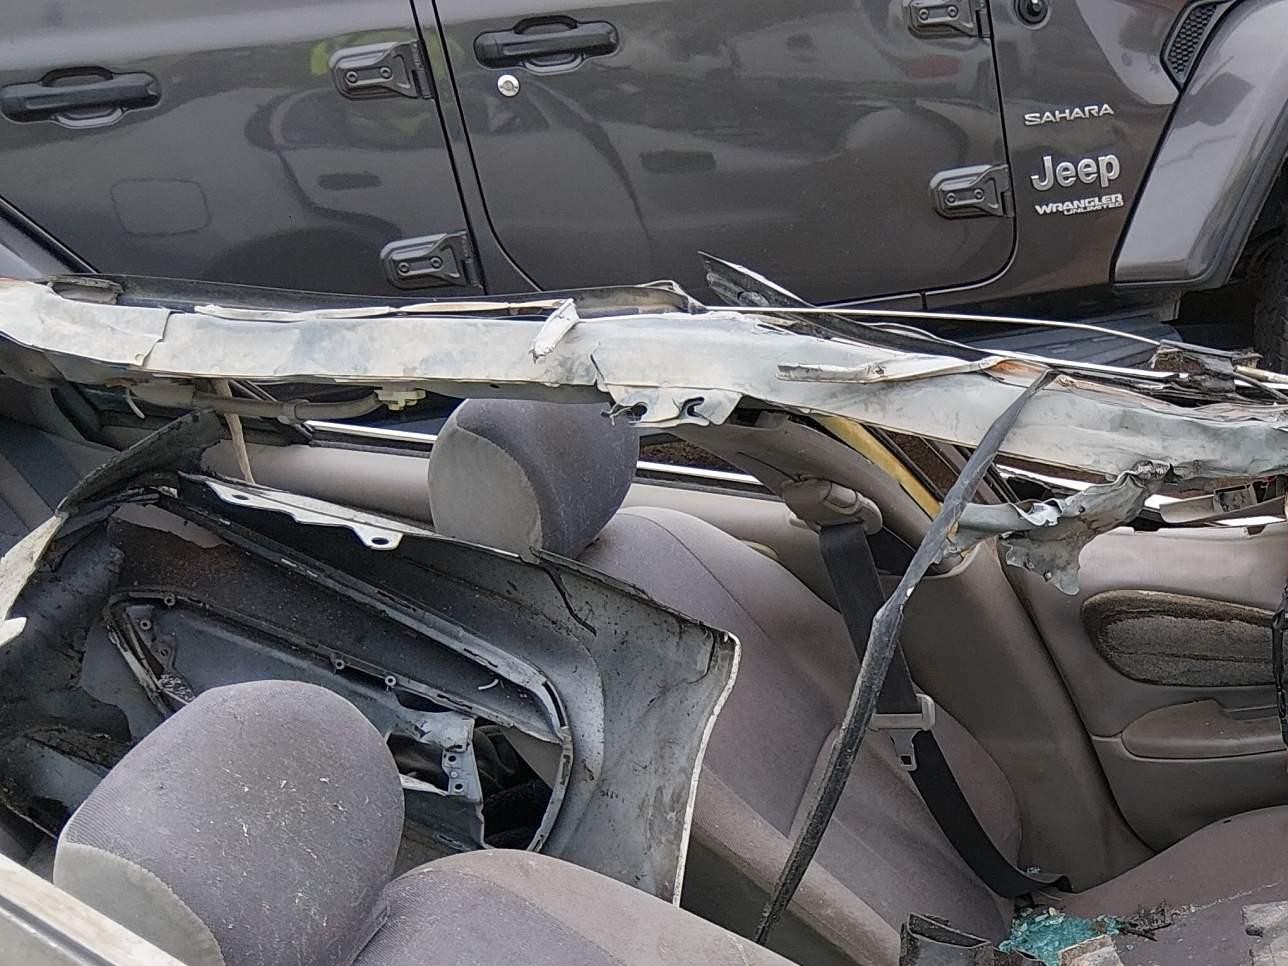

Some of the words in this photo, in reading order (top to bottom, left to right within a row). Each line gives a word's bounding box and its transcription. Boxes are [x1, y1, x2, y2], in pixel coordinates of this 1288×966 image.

[1024, 104, 1115, 125] SAHARA
[1030, 153, 1121, 191] Jeep
[1035, 193, 1123, 215] WRANGLER
[1063, 200, 1124, 216] UNLIMITED
